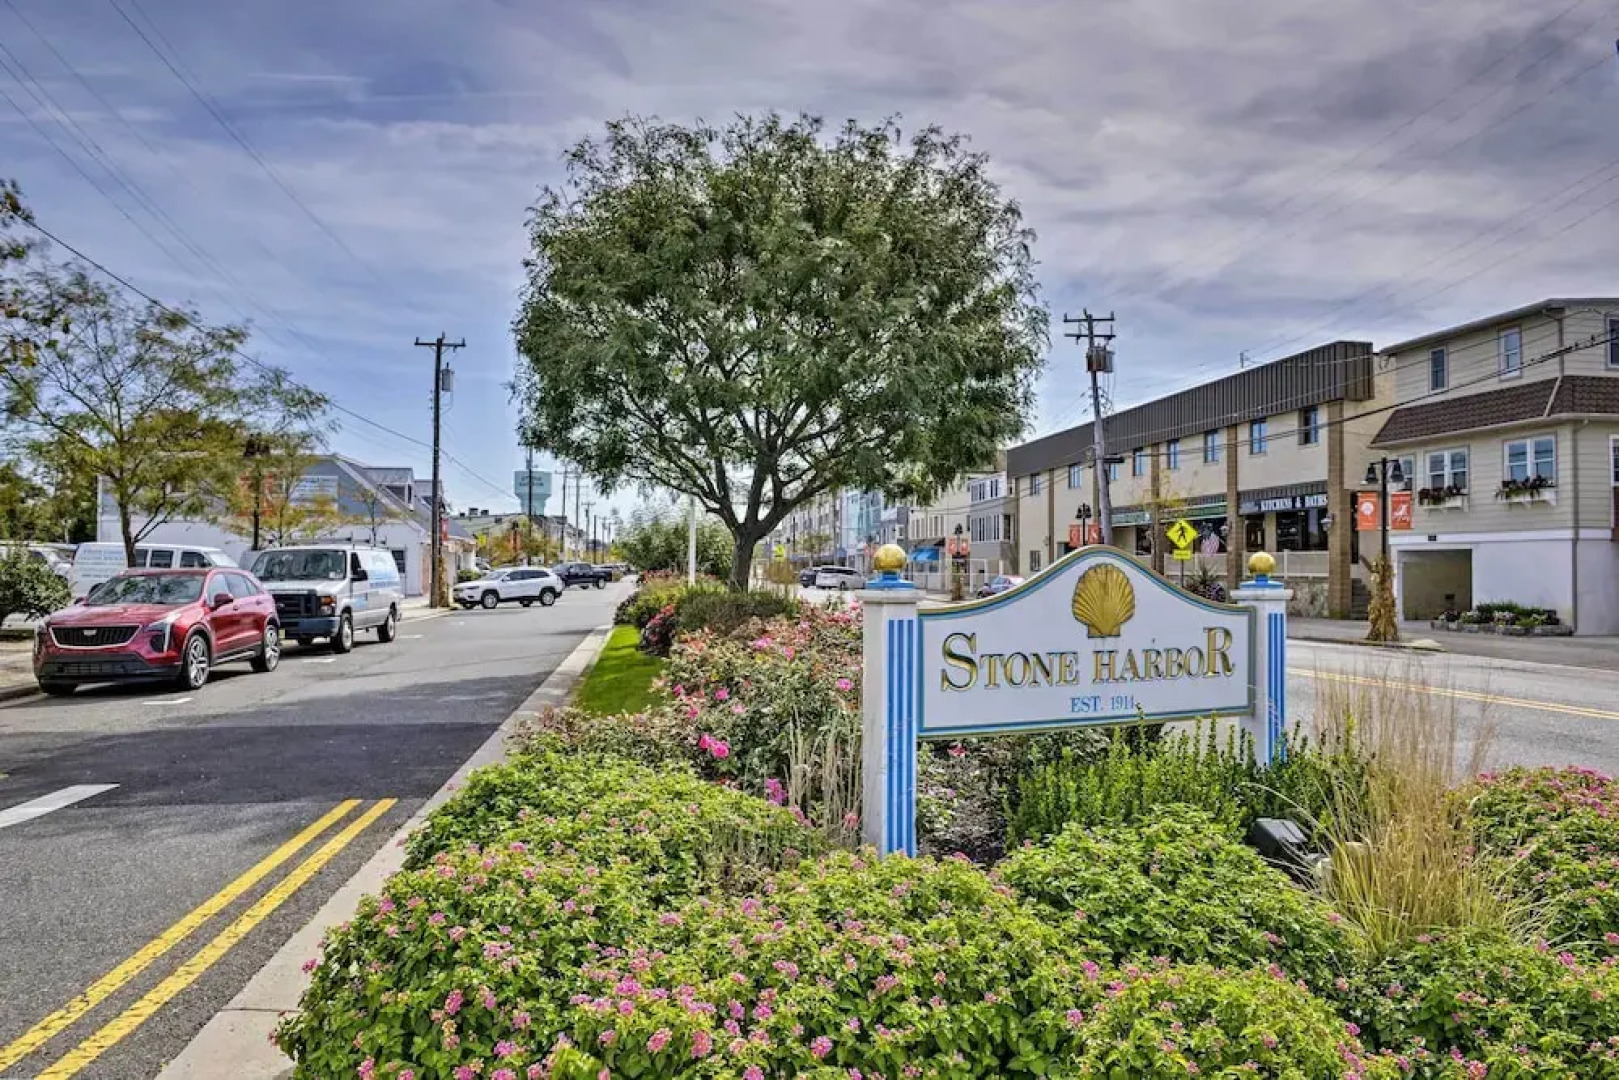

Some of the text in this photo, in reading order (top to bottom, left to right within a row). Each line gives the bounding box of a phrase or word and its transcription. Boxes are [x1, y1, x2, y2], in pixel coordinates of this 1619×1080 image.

[940, 626, 1236, 692] STONE HARBOR
[1070, 695, 1104, 713] EST.
